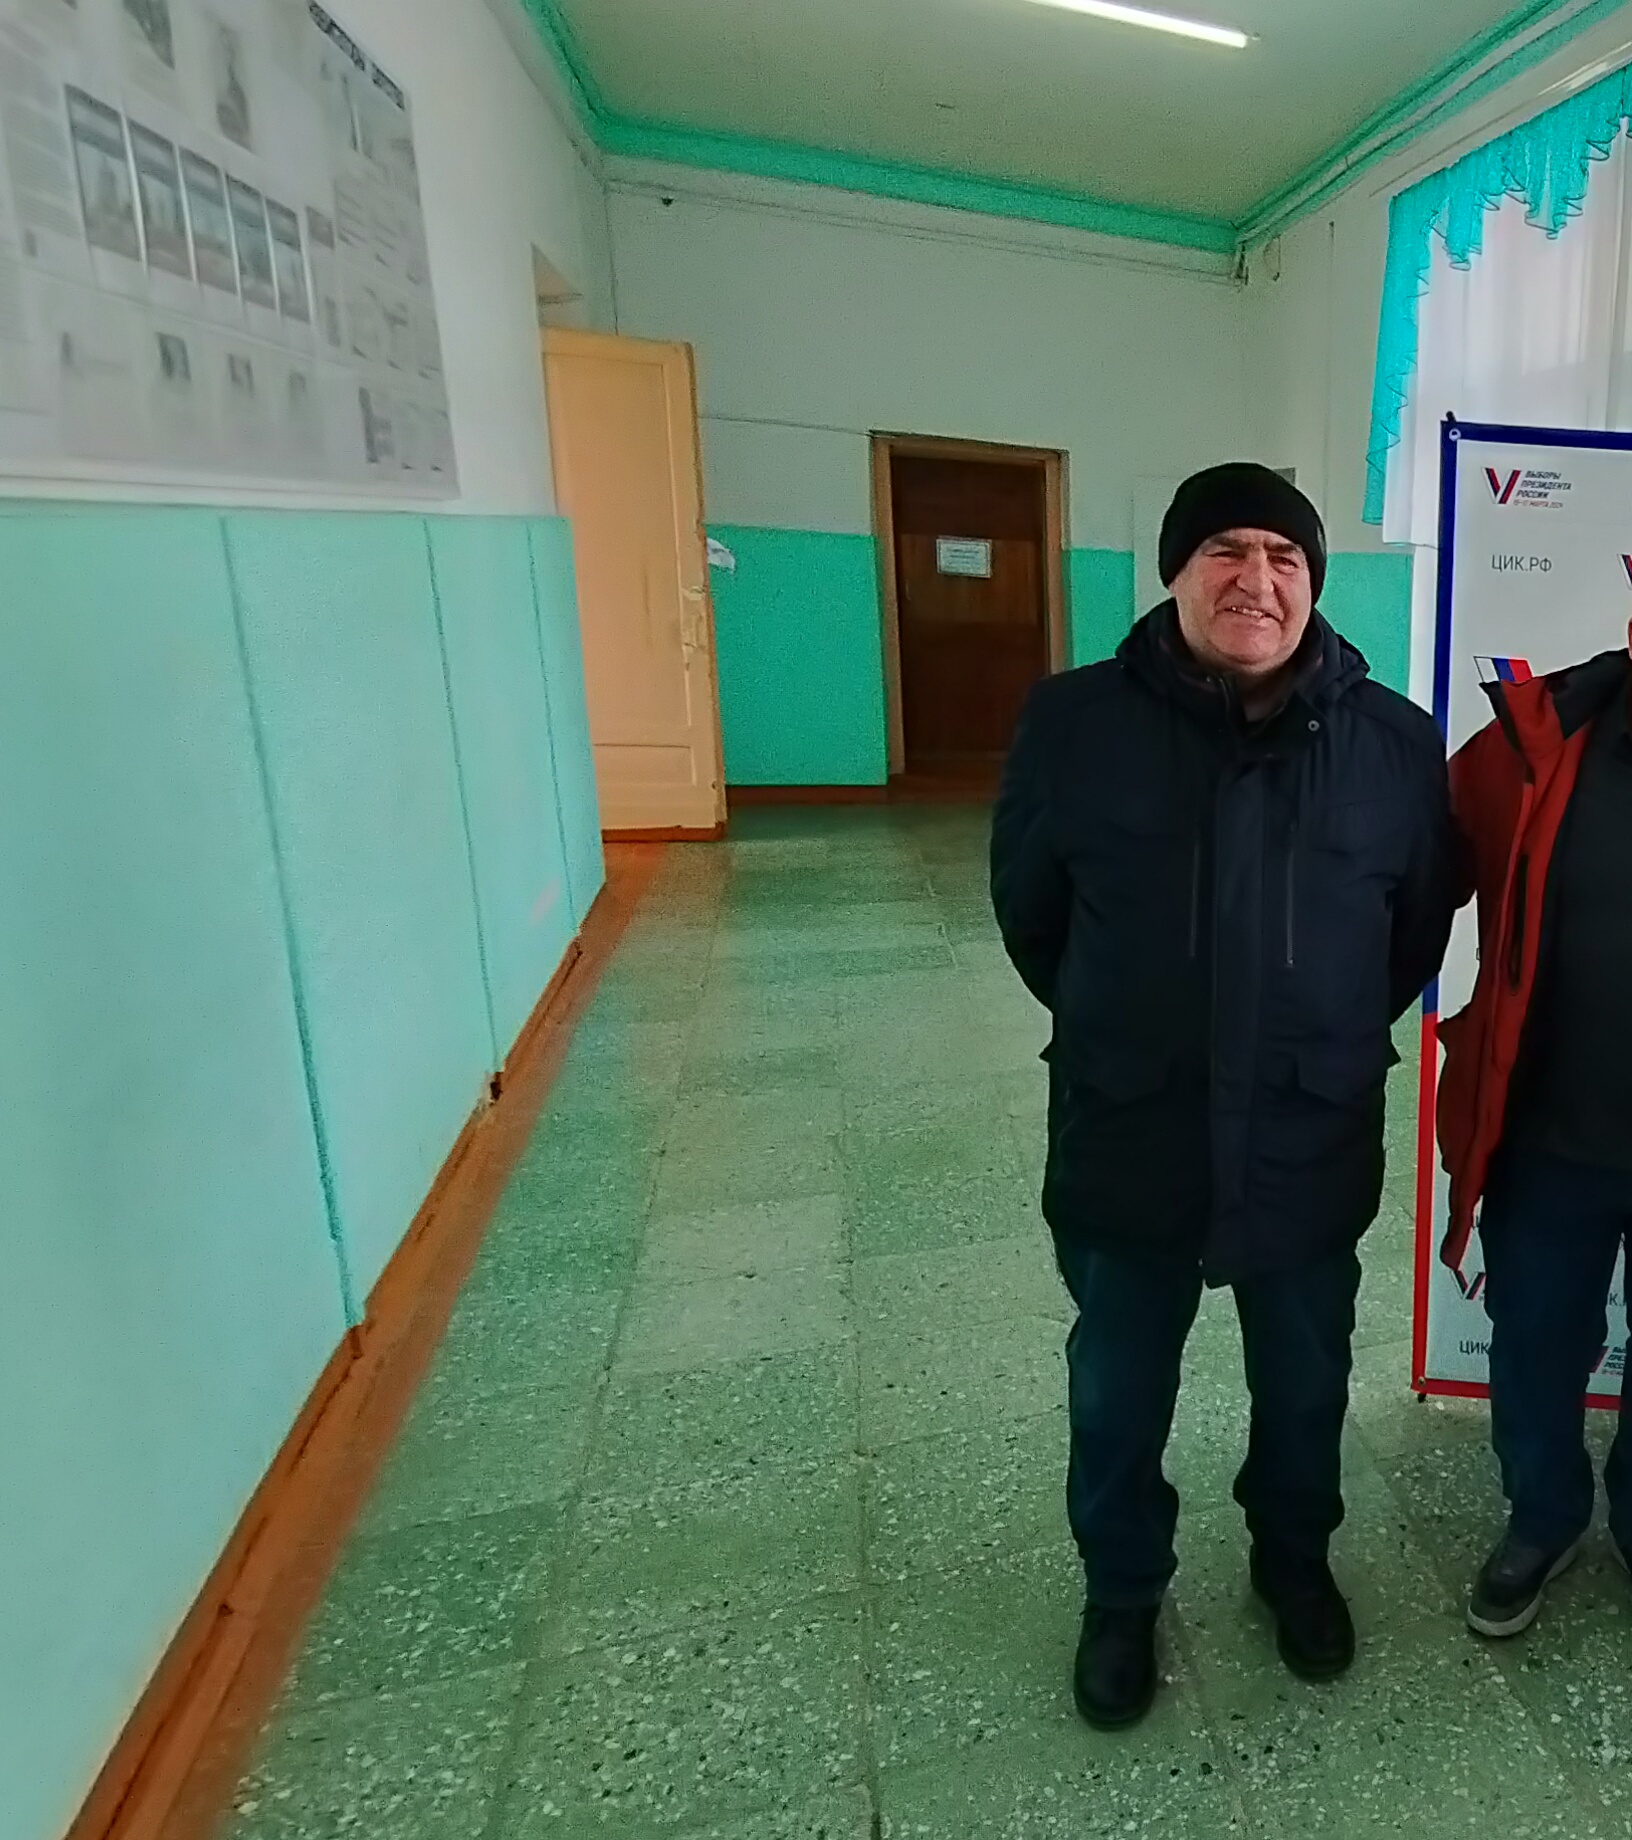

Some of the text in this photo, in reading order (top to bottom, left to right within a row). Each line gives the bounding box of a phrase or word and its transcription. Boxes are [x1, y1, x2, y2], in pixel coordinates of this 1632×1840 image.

[1525, 470, 1561, 480] ВЫБОРЫ
[1521, 480, 1572, 490] ПРЕЗИДЕНТА
[1516, 490, 1549, 499] РОССИИ
[1491, 554, 1552, 573] ЦИК.РФ
[1460, 1340, 1489, 1355] ЦИК
